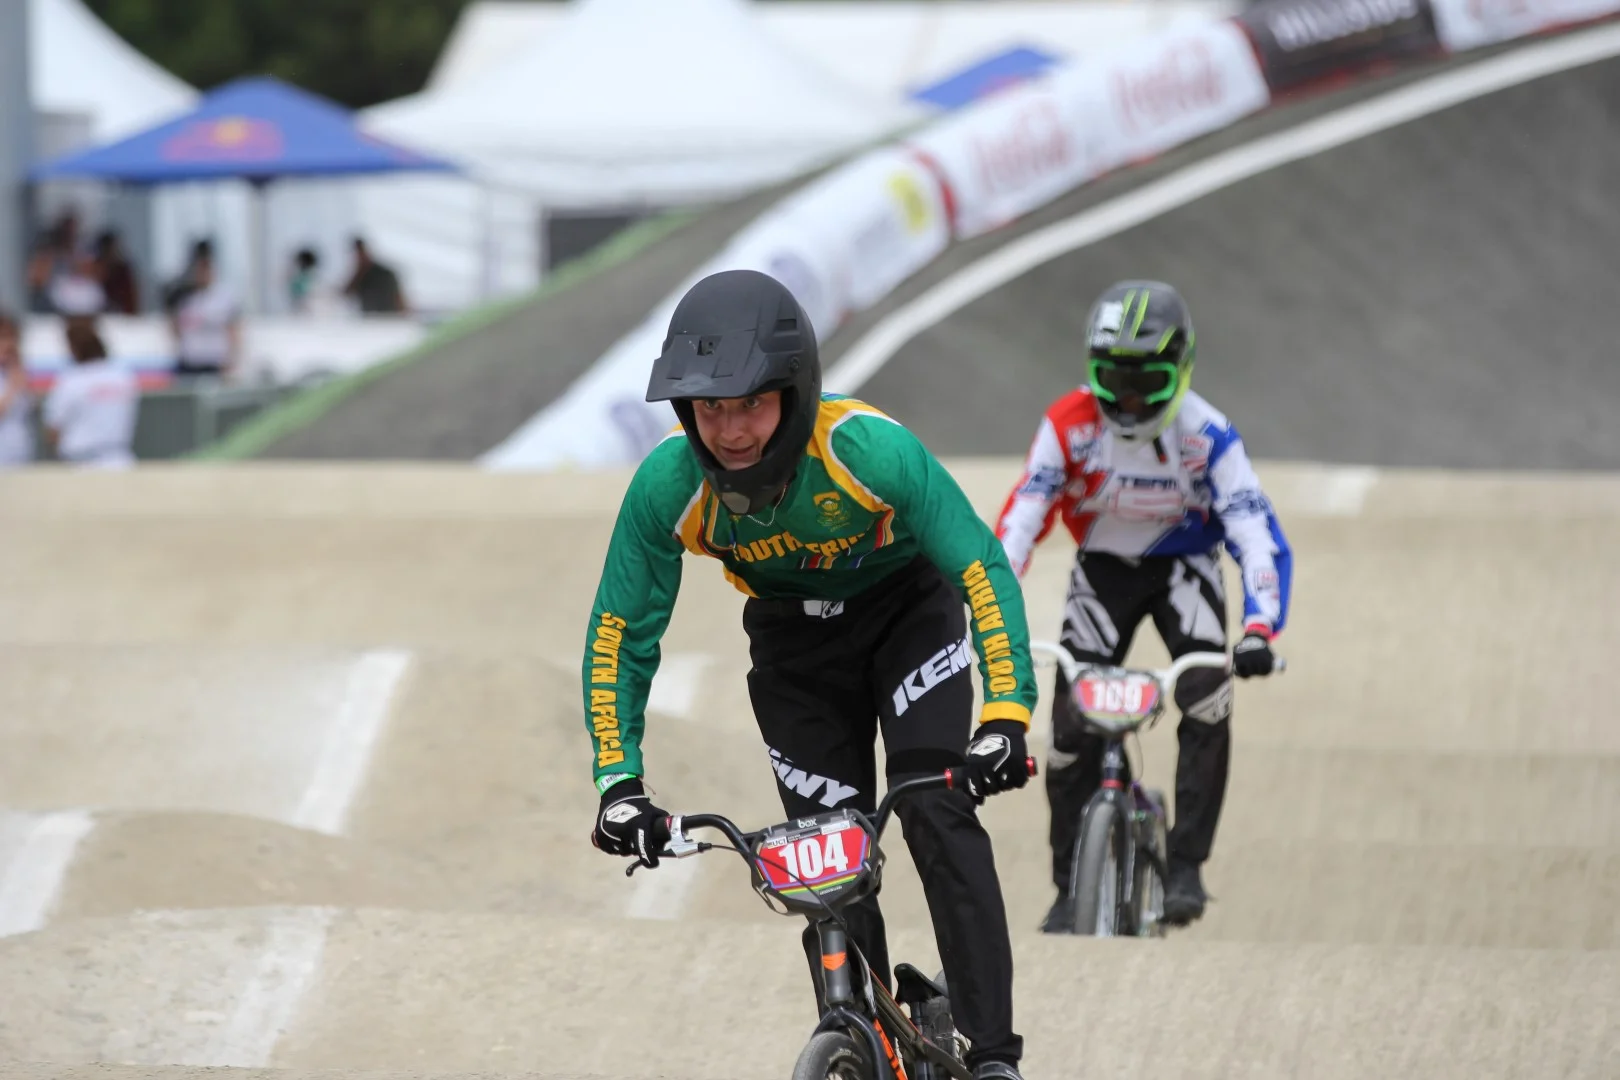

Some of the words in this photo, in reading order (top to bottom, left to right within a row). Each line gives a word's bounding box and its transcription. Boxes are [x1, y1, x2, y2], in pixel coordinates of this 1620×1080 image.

[591, 612, 627, 684] SOUTH
[591, 689, 625, 769] AFRICA
[797, 818, 817, 829] box
[778, 832, 849, 883] 104
